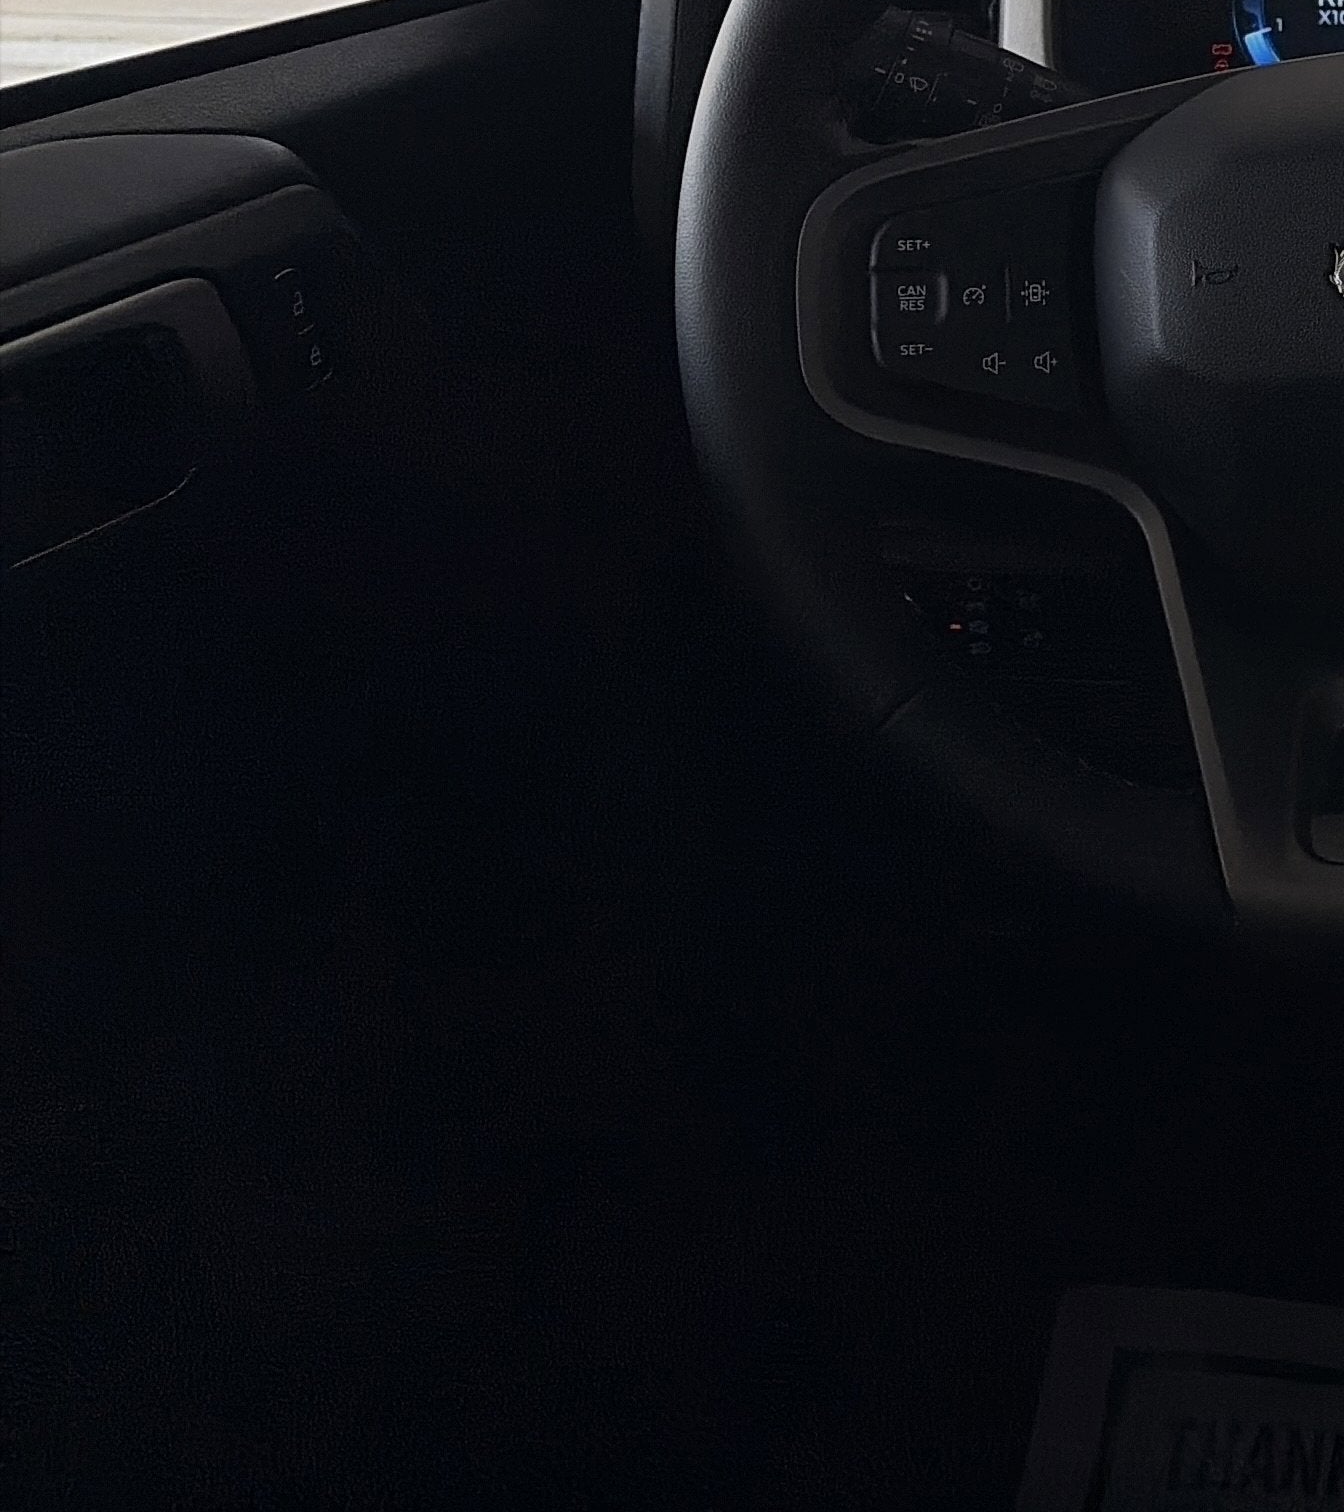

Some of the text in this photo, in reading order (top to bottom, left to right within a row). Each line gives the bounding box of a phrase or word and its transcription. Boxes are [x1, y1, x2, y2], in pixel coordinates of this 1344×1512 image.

[1275, 17, 1283, 32] 1
[897, 239, 932, 252] SET+
[898, 285, 927, 297] CAN
[900, 300, 925, 311] RES
